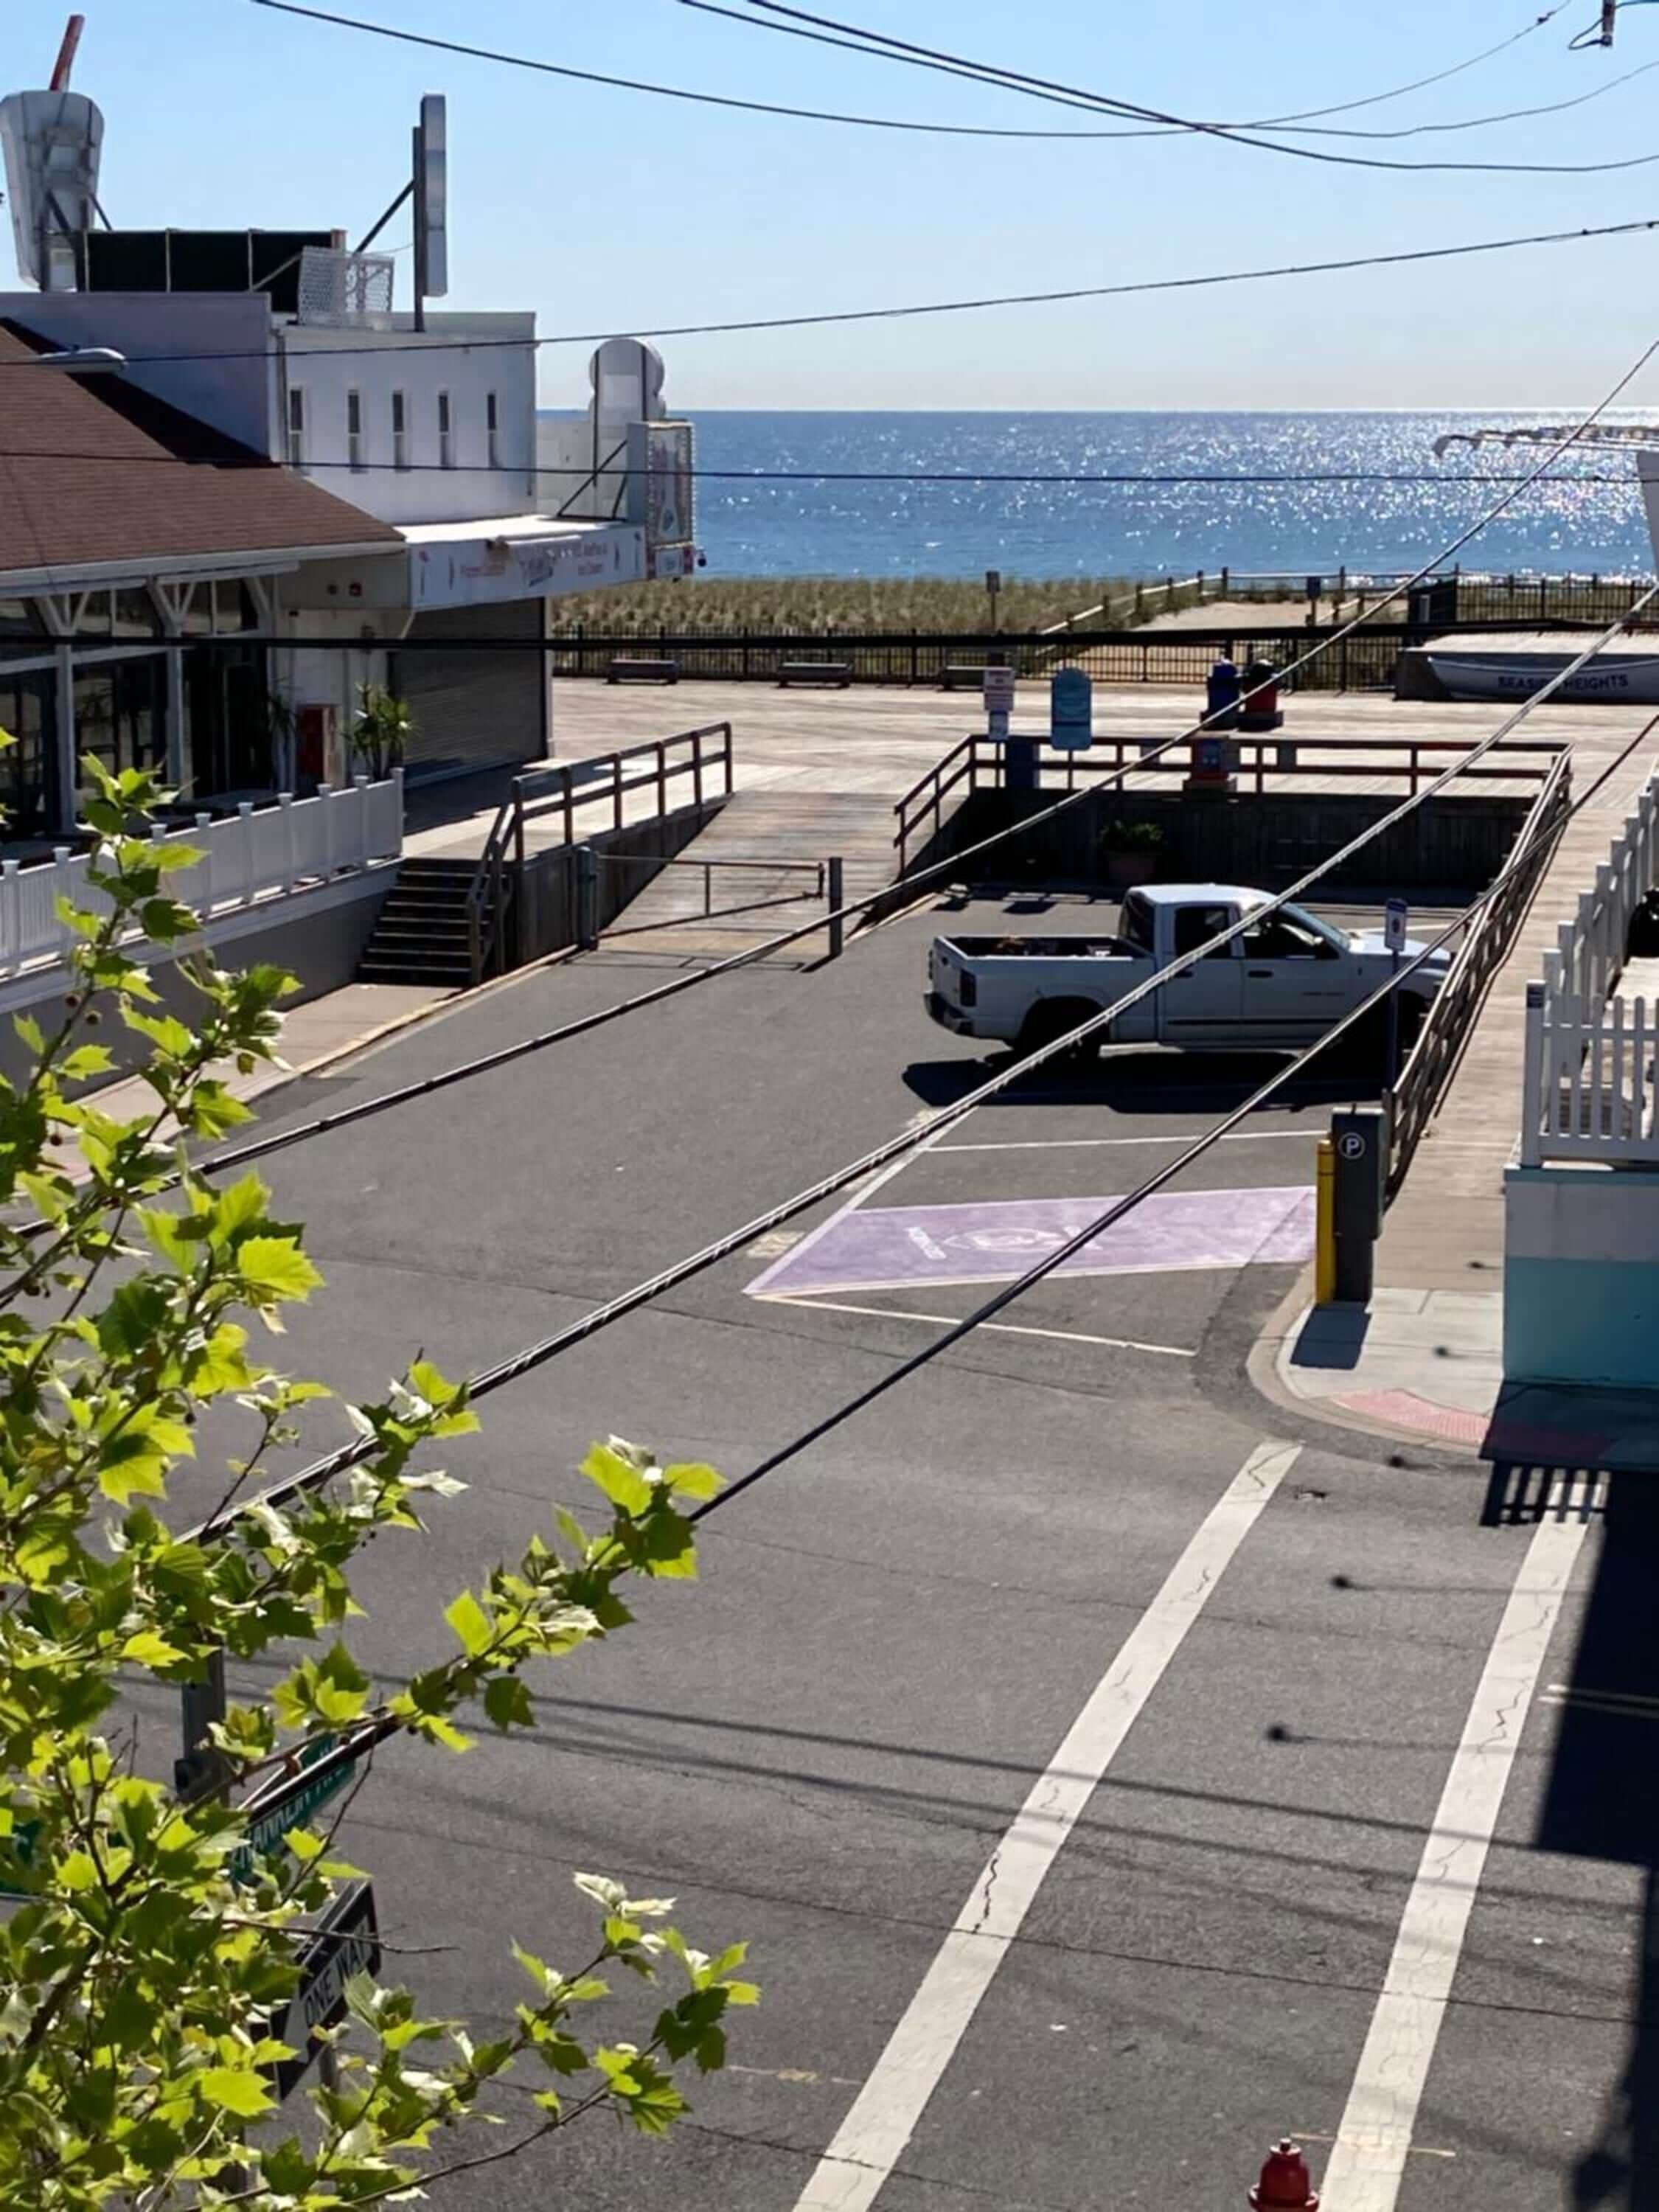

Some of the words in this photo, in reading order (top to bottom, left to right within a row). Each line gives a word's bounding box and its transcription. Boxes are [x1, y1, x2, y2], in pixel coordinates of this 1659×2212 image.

[1562, 674, 1628, 690] HEIGHTS
[1346, 1138, 1360, 1155] P
[305, 1967, 333, 2028] ONE
[336, 1919, 369, 1983] WAY
